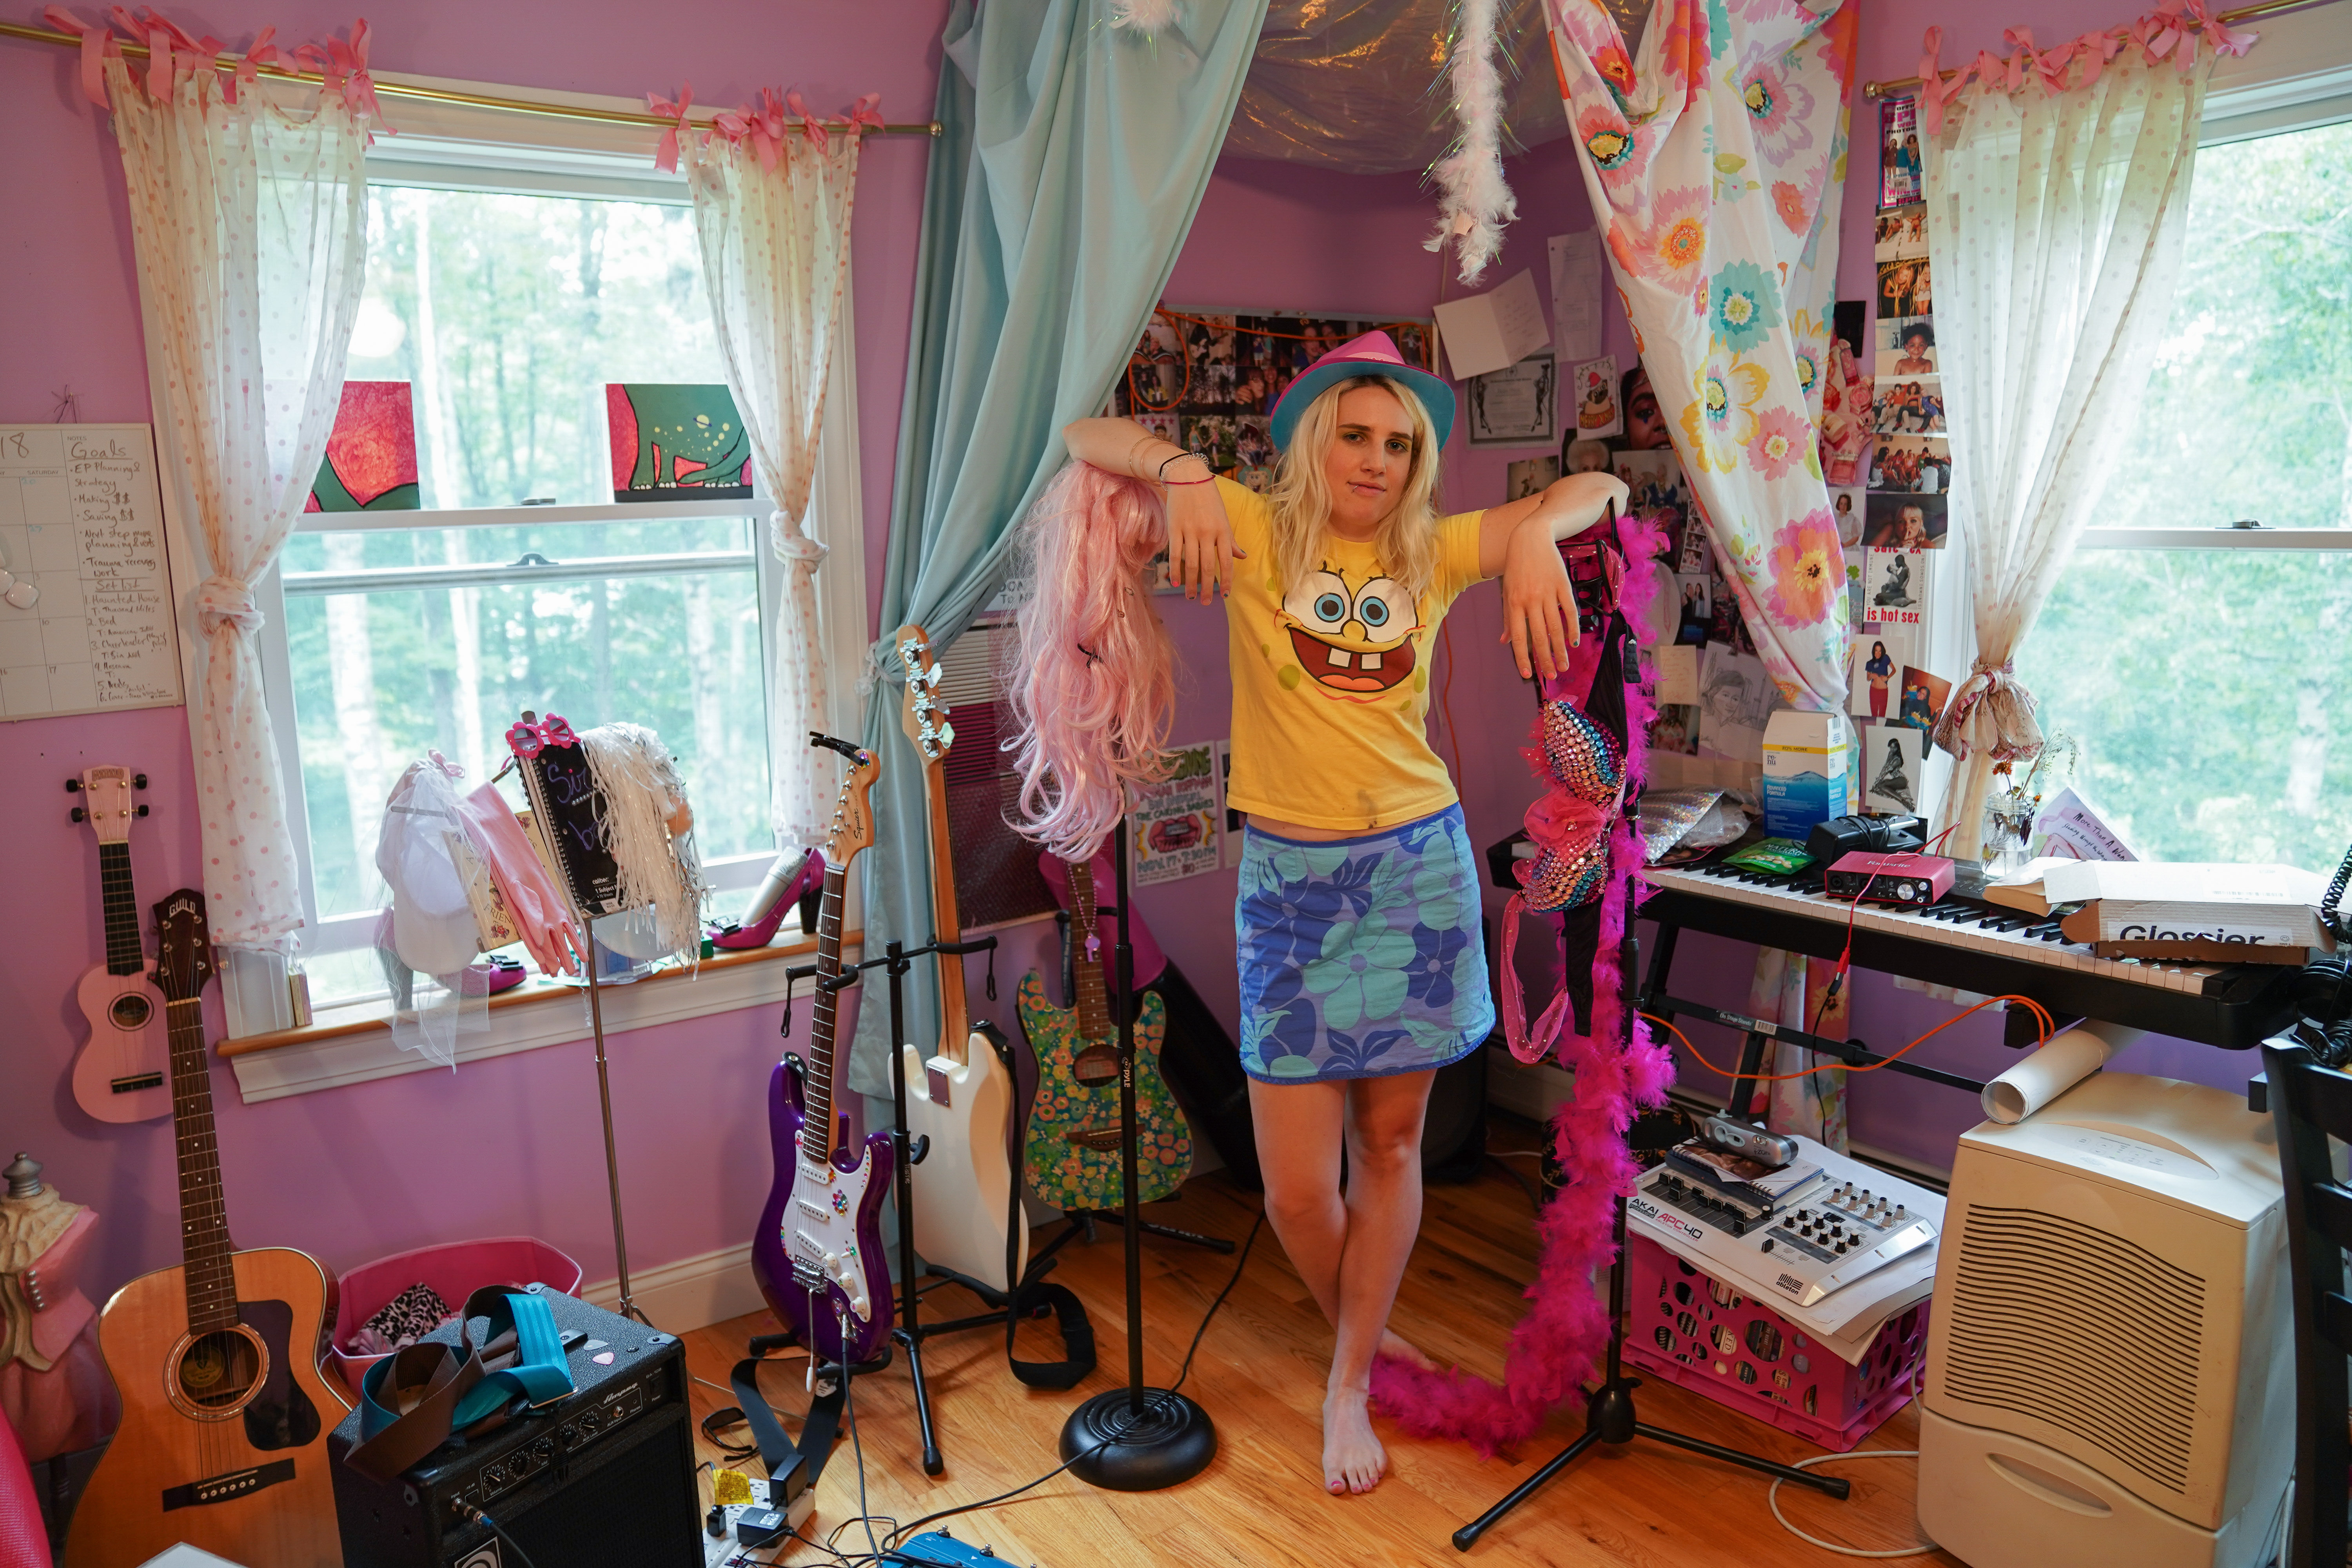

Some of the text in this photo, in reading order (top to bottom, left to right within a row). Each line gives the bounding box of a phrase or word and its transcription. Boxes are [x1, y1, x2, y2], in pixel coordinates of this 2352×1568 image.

[71, 439, 126, 459] Goals
[75, 463, 91, 473] EP
[79, 494, 110, 513] Making
[83, 510, 117, 528] Saving
[1867, 607, 1919, 624] is hot sex
[853, 808, 864, 840] Squier
[2073, 812, 2091, 828] More
[2092, 826, 2106, 841] Than
[2105, 840, 2115, 849] A
[599, 885, 615, 893] Subject
[169, 897, 196, 918] GUILD
[2120, 926, 2265, 944] Glosier
[1726, 1014, 1738, 1024] Stage
[1738, 1018, 1752, 1026] Stands
[1629, 1203, 1655, 1219] professional
[1632, 1198, 1659, 1215] AKAI
[1655, 1219, 1699, 1242] ABLETON CONTROLLER
[1657, 1213, 1703, 1240] APC40
[1776, 1281, 1799, 1295] ableton
[603, 1382, 638, 1405] Ampeg
[490, 1487, 502, 1496] Volume
